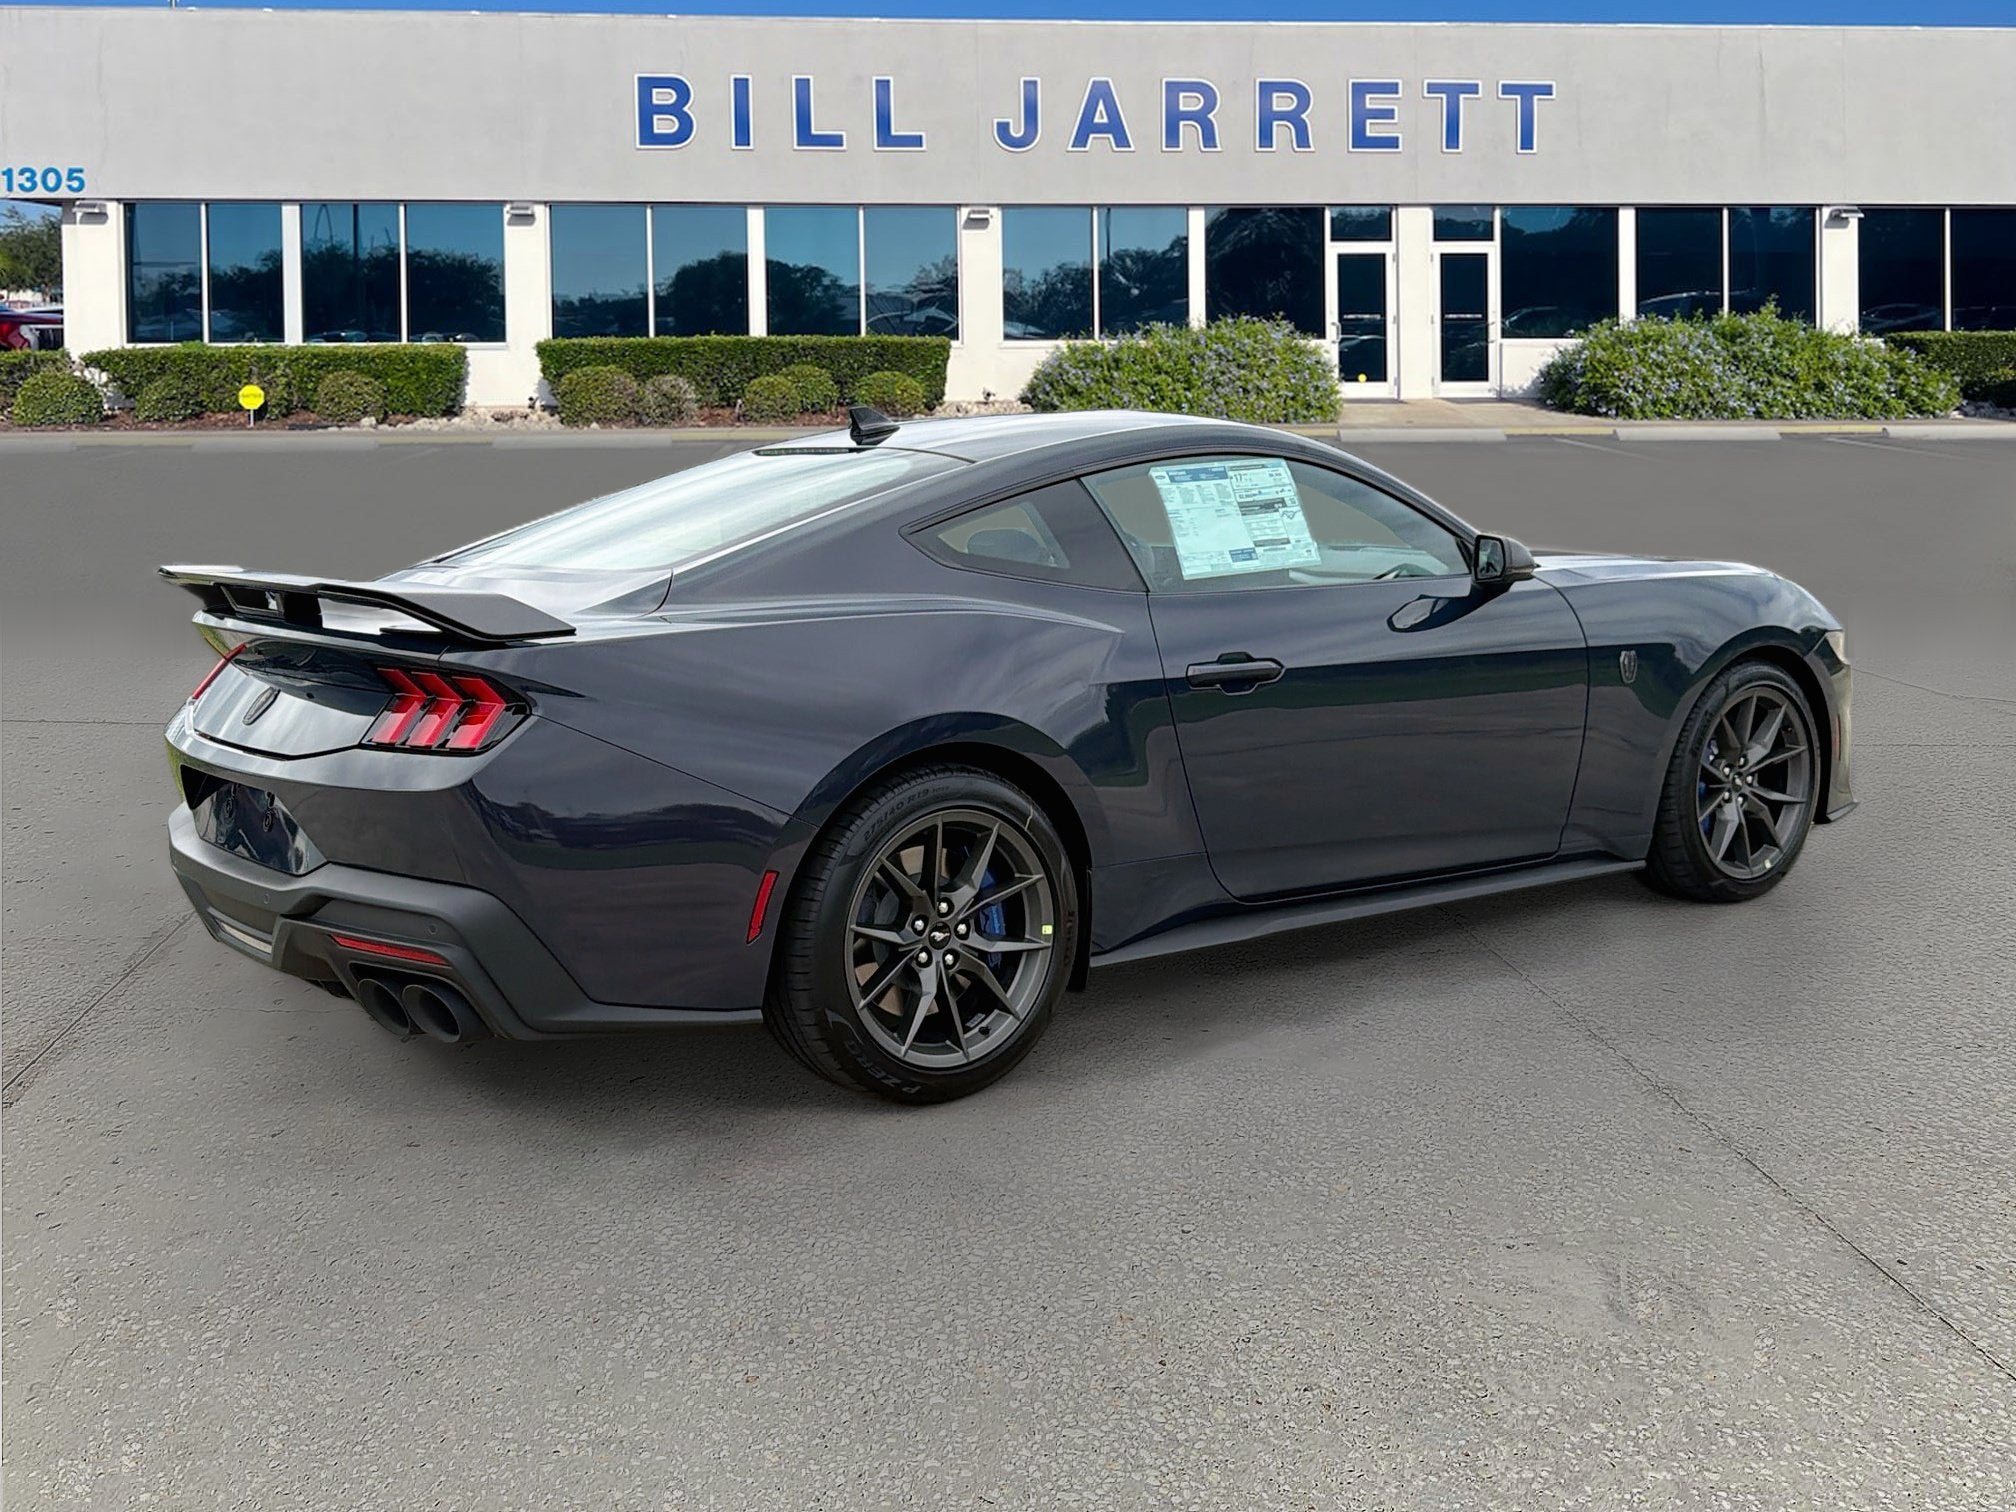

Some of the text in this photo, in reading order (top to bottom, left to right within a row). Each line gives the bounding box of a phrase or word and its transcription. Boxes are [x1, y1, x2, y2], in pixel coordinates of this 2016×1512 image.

[635, 73, 1556, 153] BILL JARRETT
[1, 167, 85, 193] 1305
